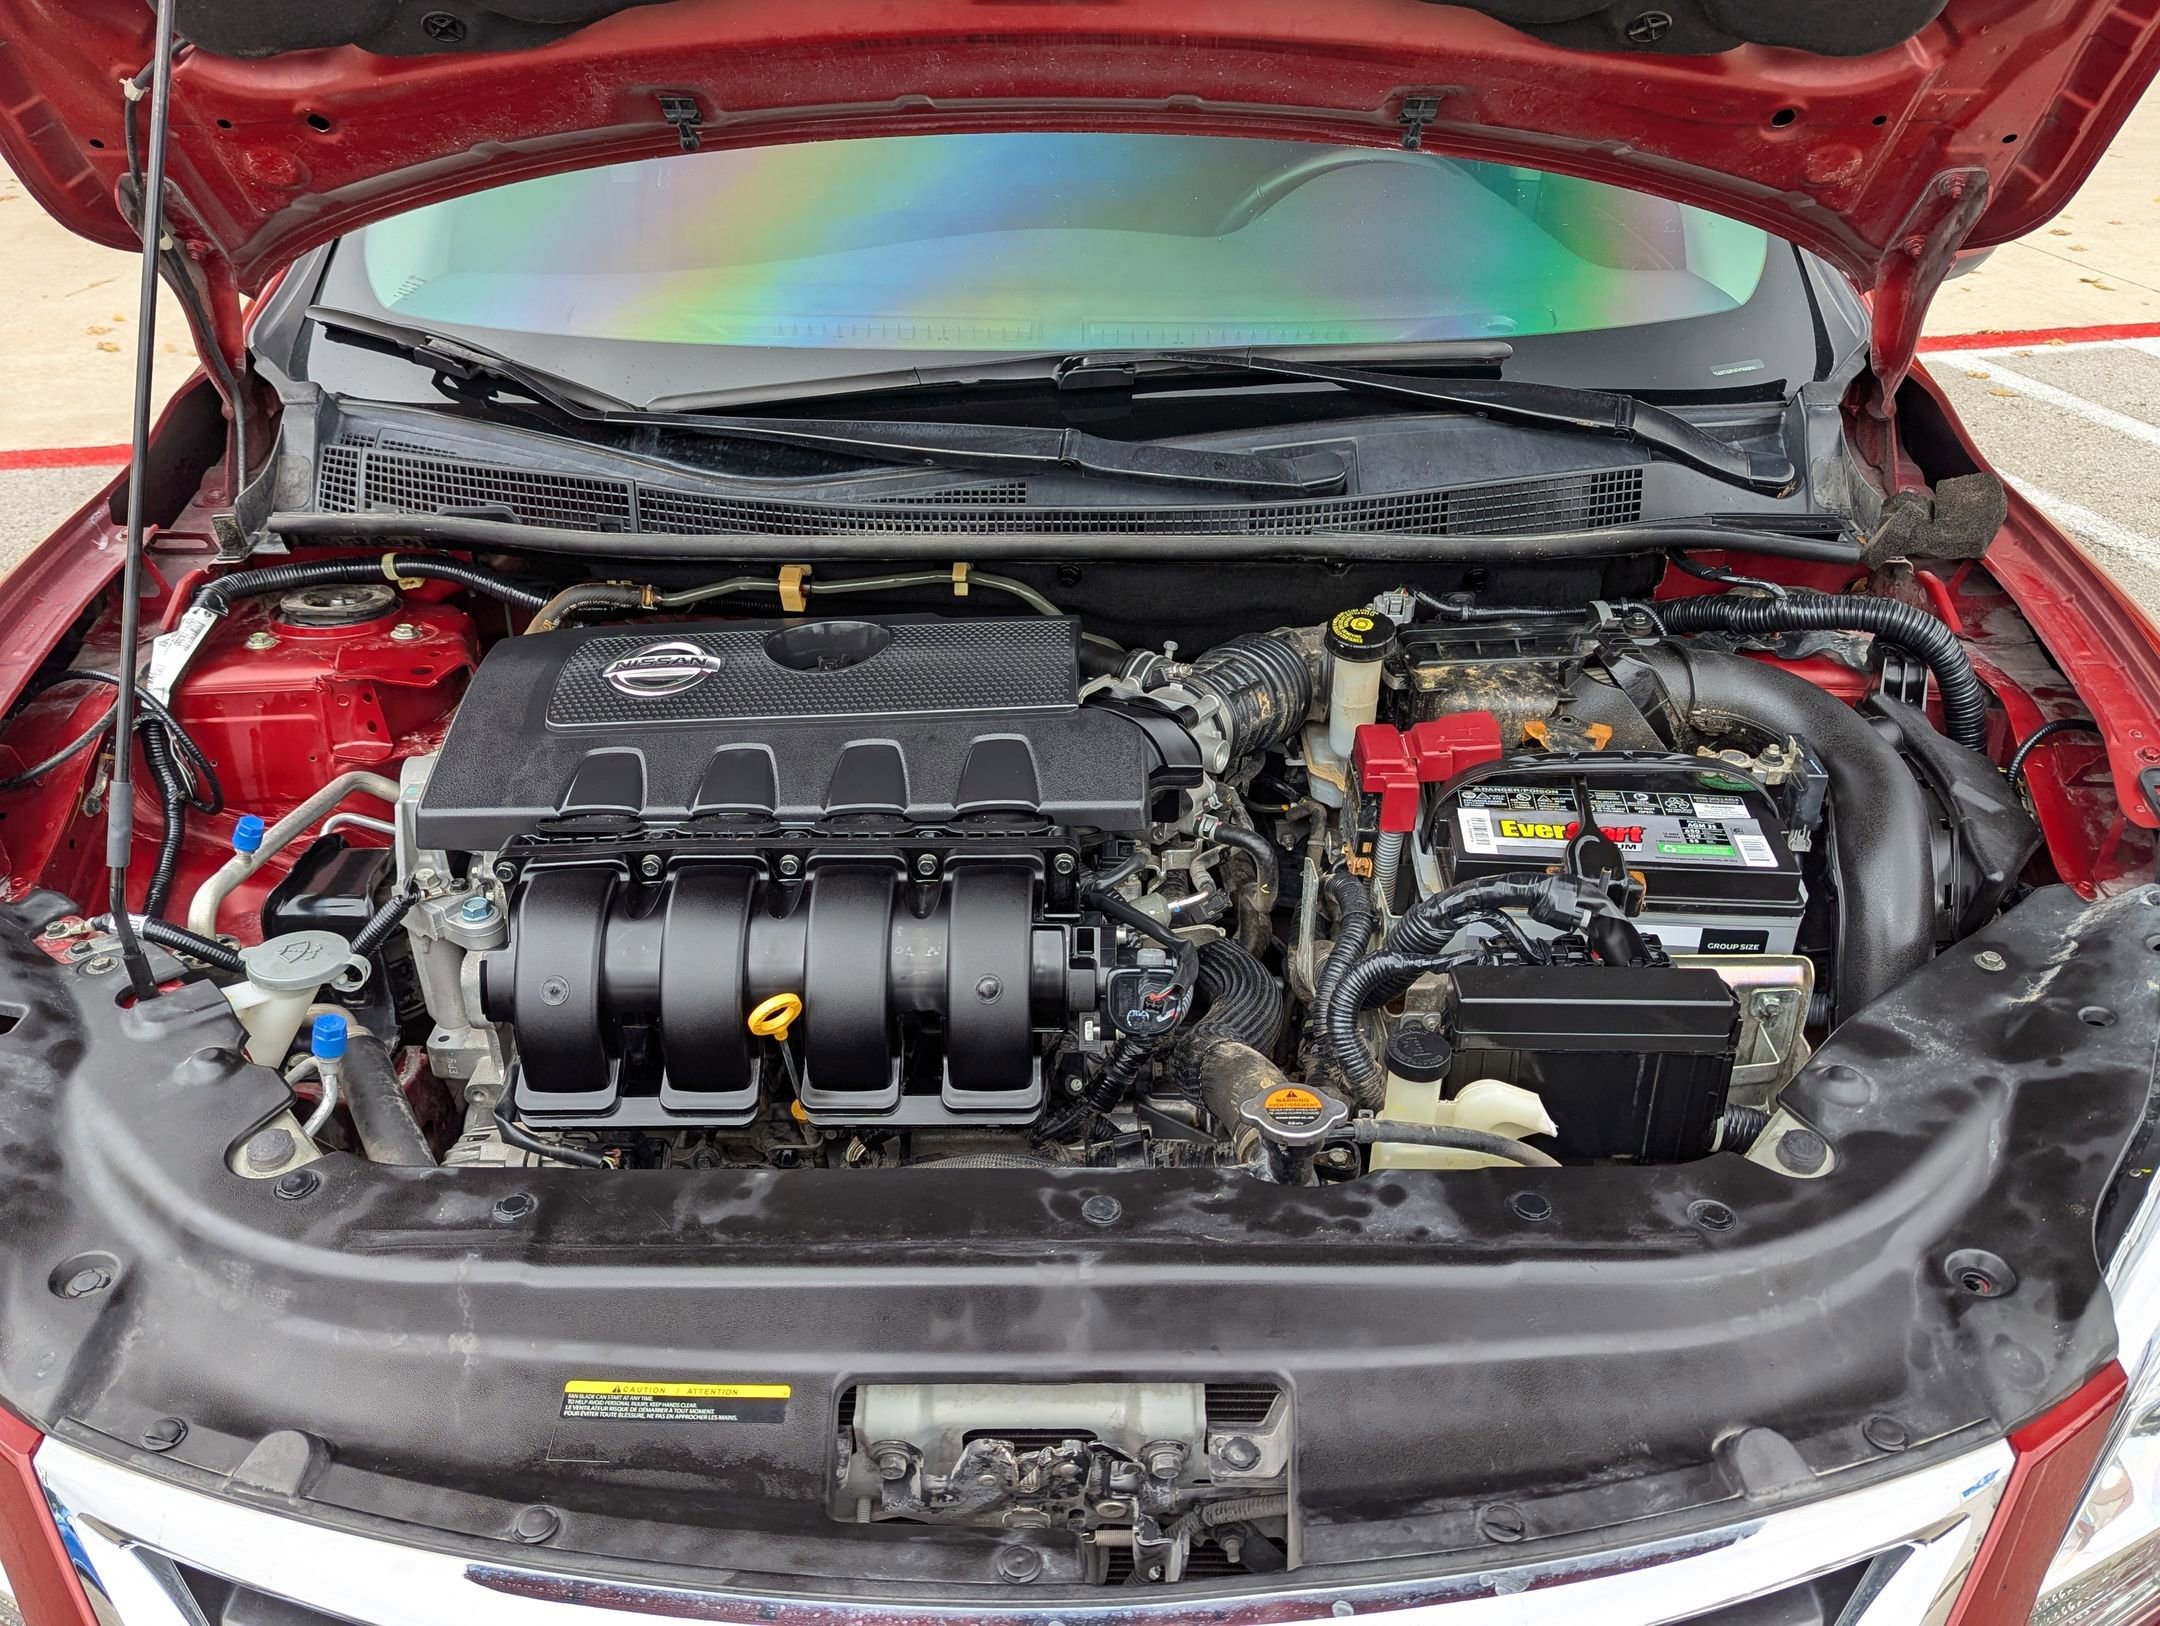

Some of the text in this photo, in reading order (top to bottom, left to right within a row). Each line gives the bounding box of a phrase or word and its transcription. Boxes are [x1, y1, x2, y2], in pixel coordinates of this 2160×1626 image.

[614, 656, 709, 670] NISSAN
[1499, 819, 1644, 843] EverSart
[1707, 942, 1760, 951] GROUP SIZE
[623, 1386, 666, 1394] CAUTION
[687, 1388, 738, 1396] ATTENTION
